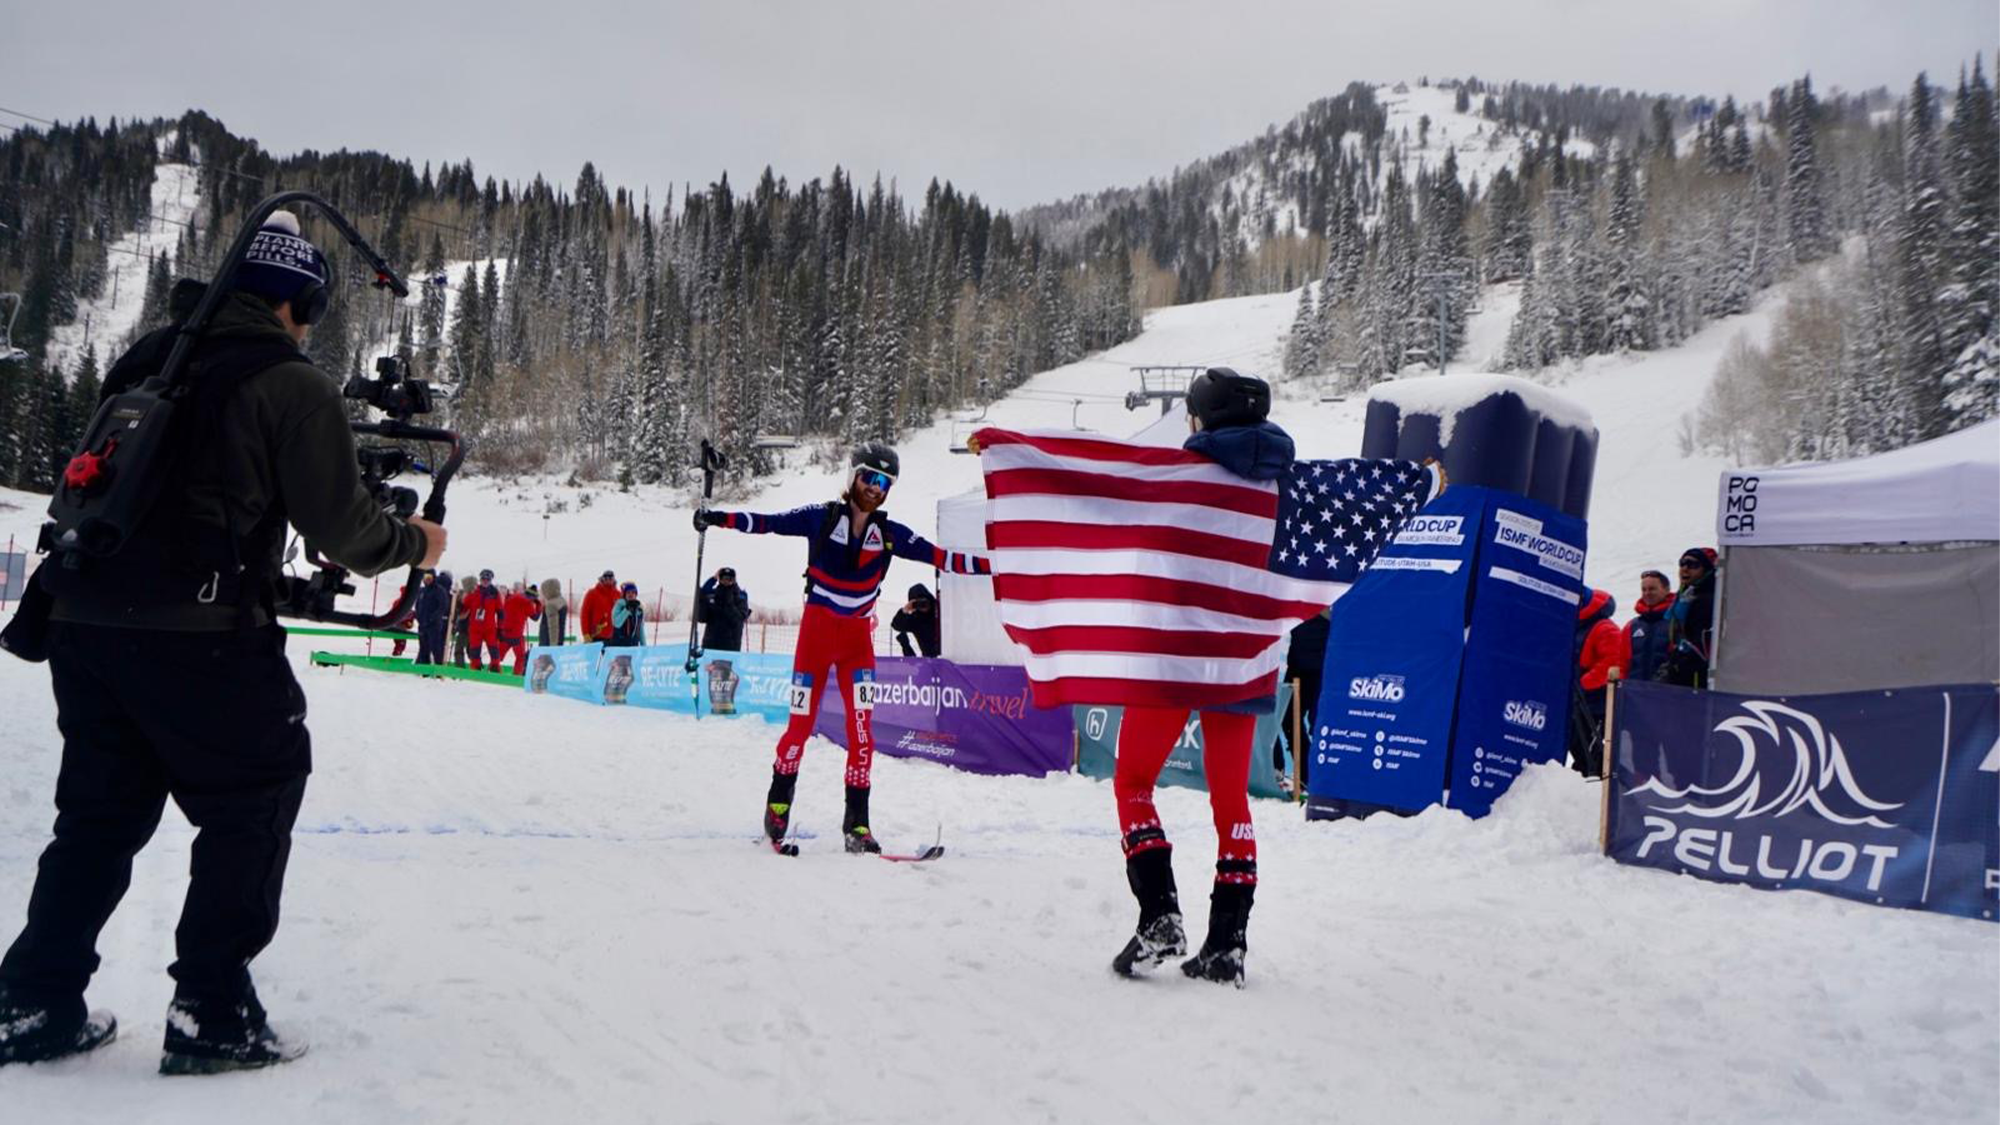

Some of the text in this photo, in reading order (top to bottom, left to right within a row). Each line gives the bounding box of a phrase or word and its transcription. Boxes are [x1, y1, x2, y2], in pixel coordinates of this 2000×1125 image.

[249, 242, 314, 264] BEFORE
[253, 235, 314, 254] PLANTS
[873, 675, 968, 717] azerbaijan
[1350, 678, 1404, 701] SkiMo
[1504, 702, 1546, 730] SkiMo
[1636, 816, 1899, 891] PELLIOT
